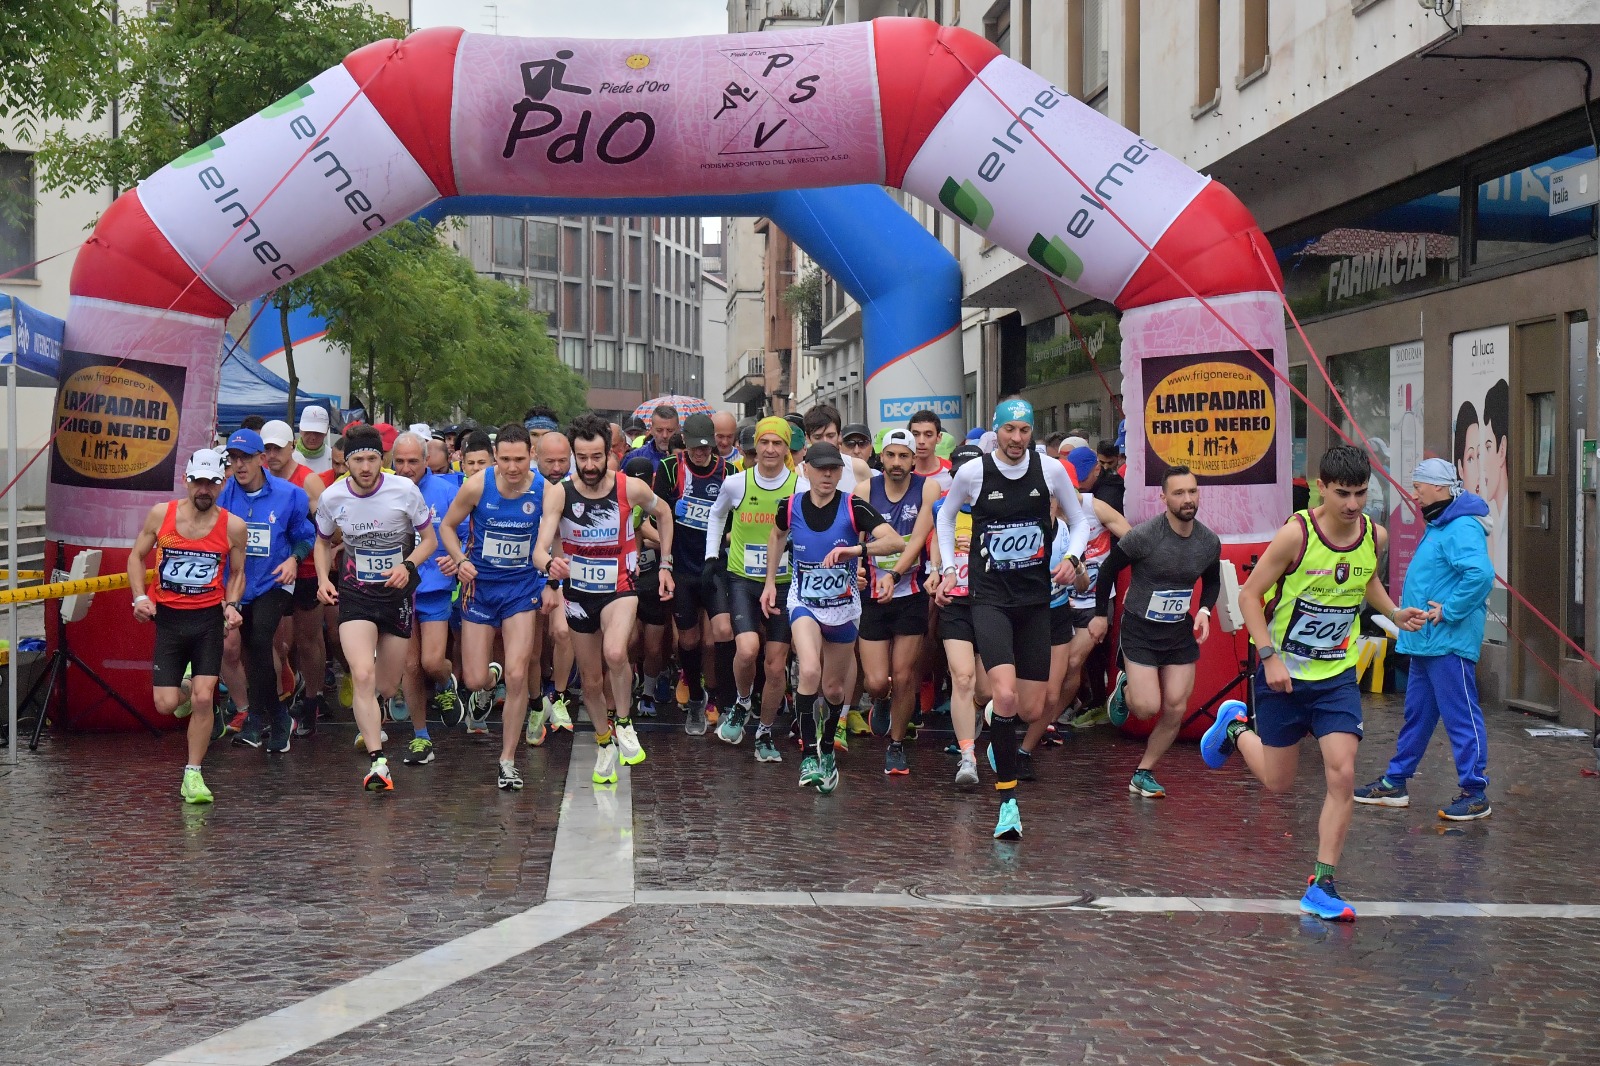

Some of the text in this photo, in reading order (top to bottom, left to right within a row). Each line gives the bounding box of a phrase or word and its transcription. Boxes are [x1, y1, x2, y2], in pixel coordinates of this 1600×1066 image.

[762, 53, 794, 77] P
[599, 80, 670, 94] Piede d'Oro
[788, 75, 820, 104] S
[502, 97, 656, 165] PdO
[753, 119, 788, 149] V
[977, 85, 1070, 183] elmec
[700, 162, 734, 170] PODISMO
[736, 160, 770, 168] SPORTIVO
[787, 156, 829, 164] VARESOTTO
[289, 114, 367, 232] elmec
[1552, 175, 1564, 185] corso
[1066, 138, 1159, 239] elmec
[1552, 187, 1569, 205] Italia
[198, 166, 296, 280] elmec
[1327, 234, 1427, 302] FARMACIA
[1471, 339, 1494, 357] di luca
[75, 371, 155, 393] www.frigonereo.it
[1167, 369, 1253, 386] www.frigonereo.it
[64, 389, 168, 421] LAMPADARI
[883, 400, 960, 418] DECATHLON
[1156, 389, 1266, 414] LAMPADARI
[59, 416, 171, 442] FRIGO NEREO
[1152, 415, 1271, 434] FRIGO NEREO
[91, 462, 108, 474] VARESE
[1202, 461, 1219, 471] VARESE
[351, 522, 374, 532] TEAM
[582, 528, 618, 538] DOMO
[496, 543, 521, 556] 104
[993, 532, 1038, 553] 1001
[170, 562, 212, 579] 813
[366, 558, 394, 571] 135
[582, 567, 606, 581] 119
[804, 573, 845, 590] 1200
[1162, 599, 1183, 612] 176
[1300, 601, 1323, 612] Piede
[1297, 620, 1349, 642] 502
